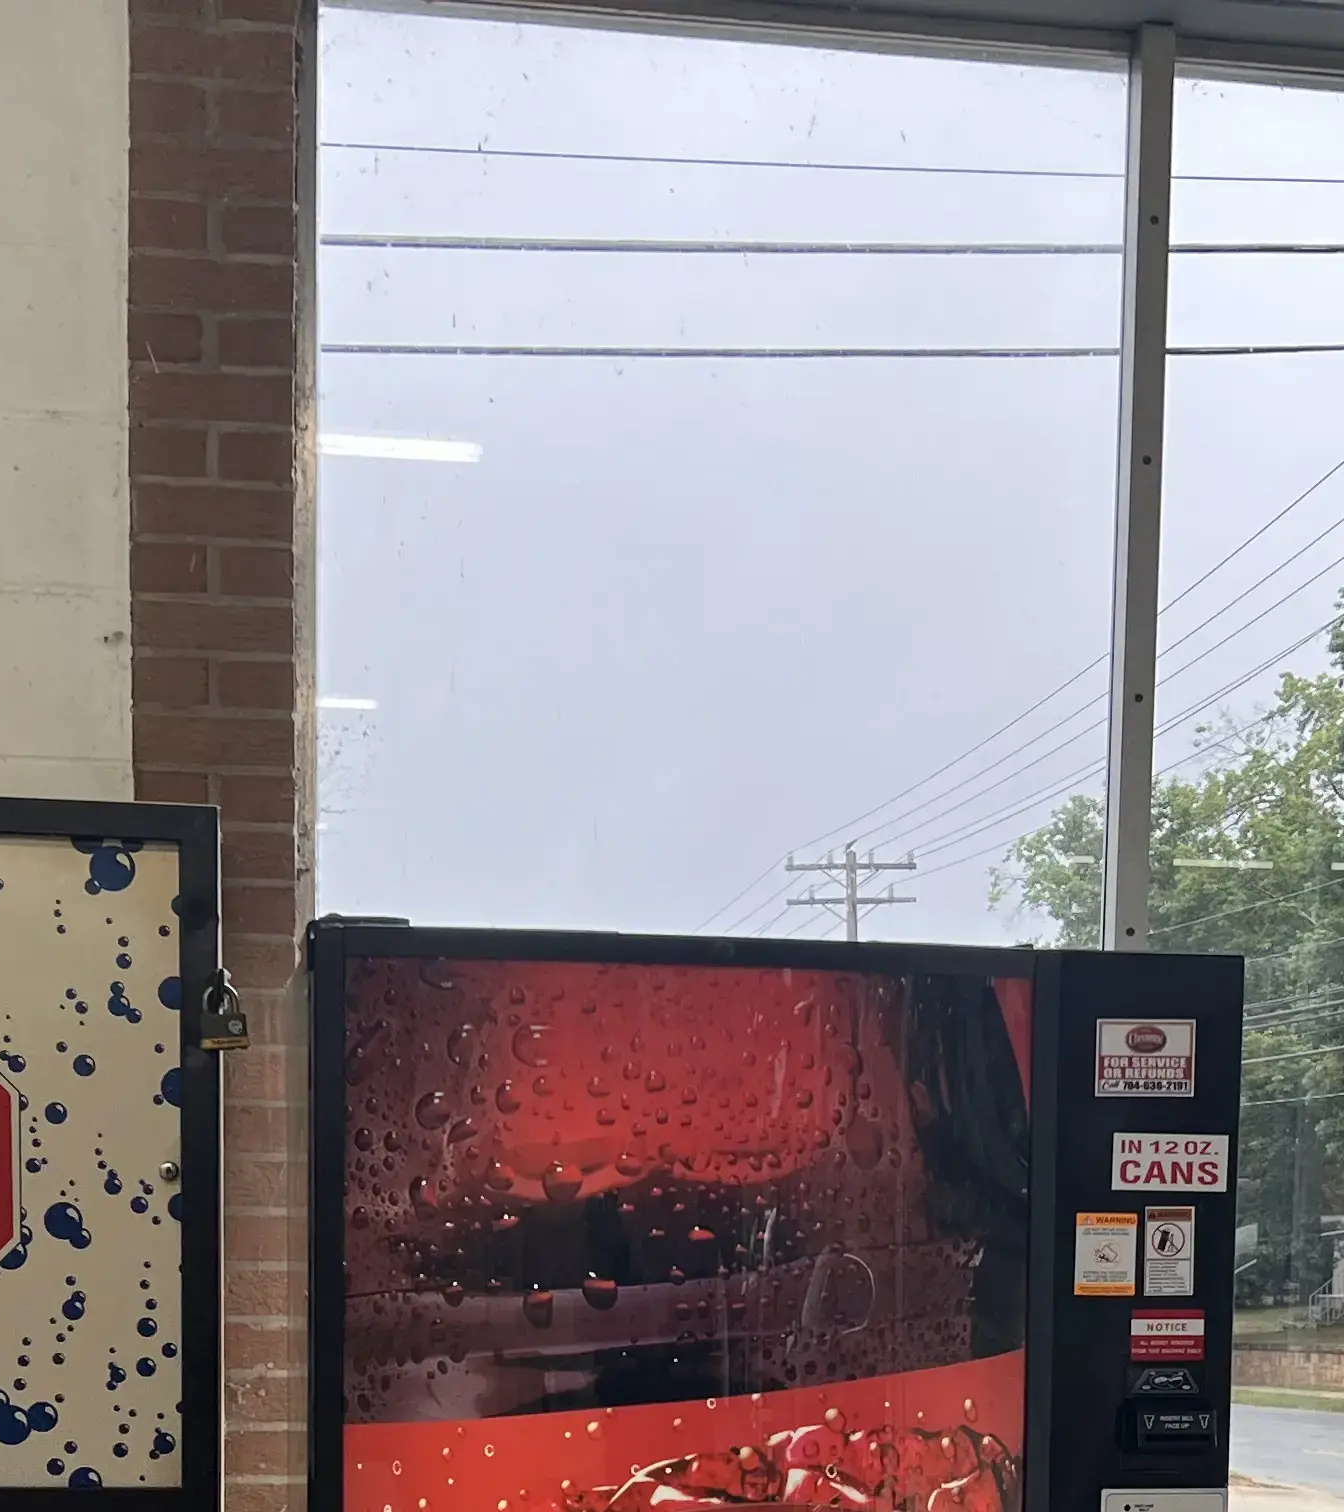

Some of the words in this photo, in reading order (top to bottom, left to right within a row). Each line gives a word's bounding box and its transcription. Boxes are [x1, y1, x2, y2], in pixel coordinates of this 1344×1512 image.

[1103, 1057, 1129, 1068] FOR
[1131, 1057, 1187, 1068] SERVICE
[1124, 1068, 1185, 1079] REFUNDS
[1120, 1139, 1142, 1154] IN
[1149, 1140, 1179, 1155] 12
[1184, 1141, 1219, 1156] OZ.
[1119, 1159, 1219, 1185] CANS
[1095, 1216, 1136, 1225] WARNING
[1146, 1322, 1188, 1332] NOTICE
